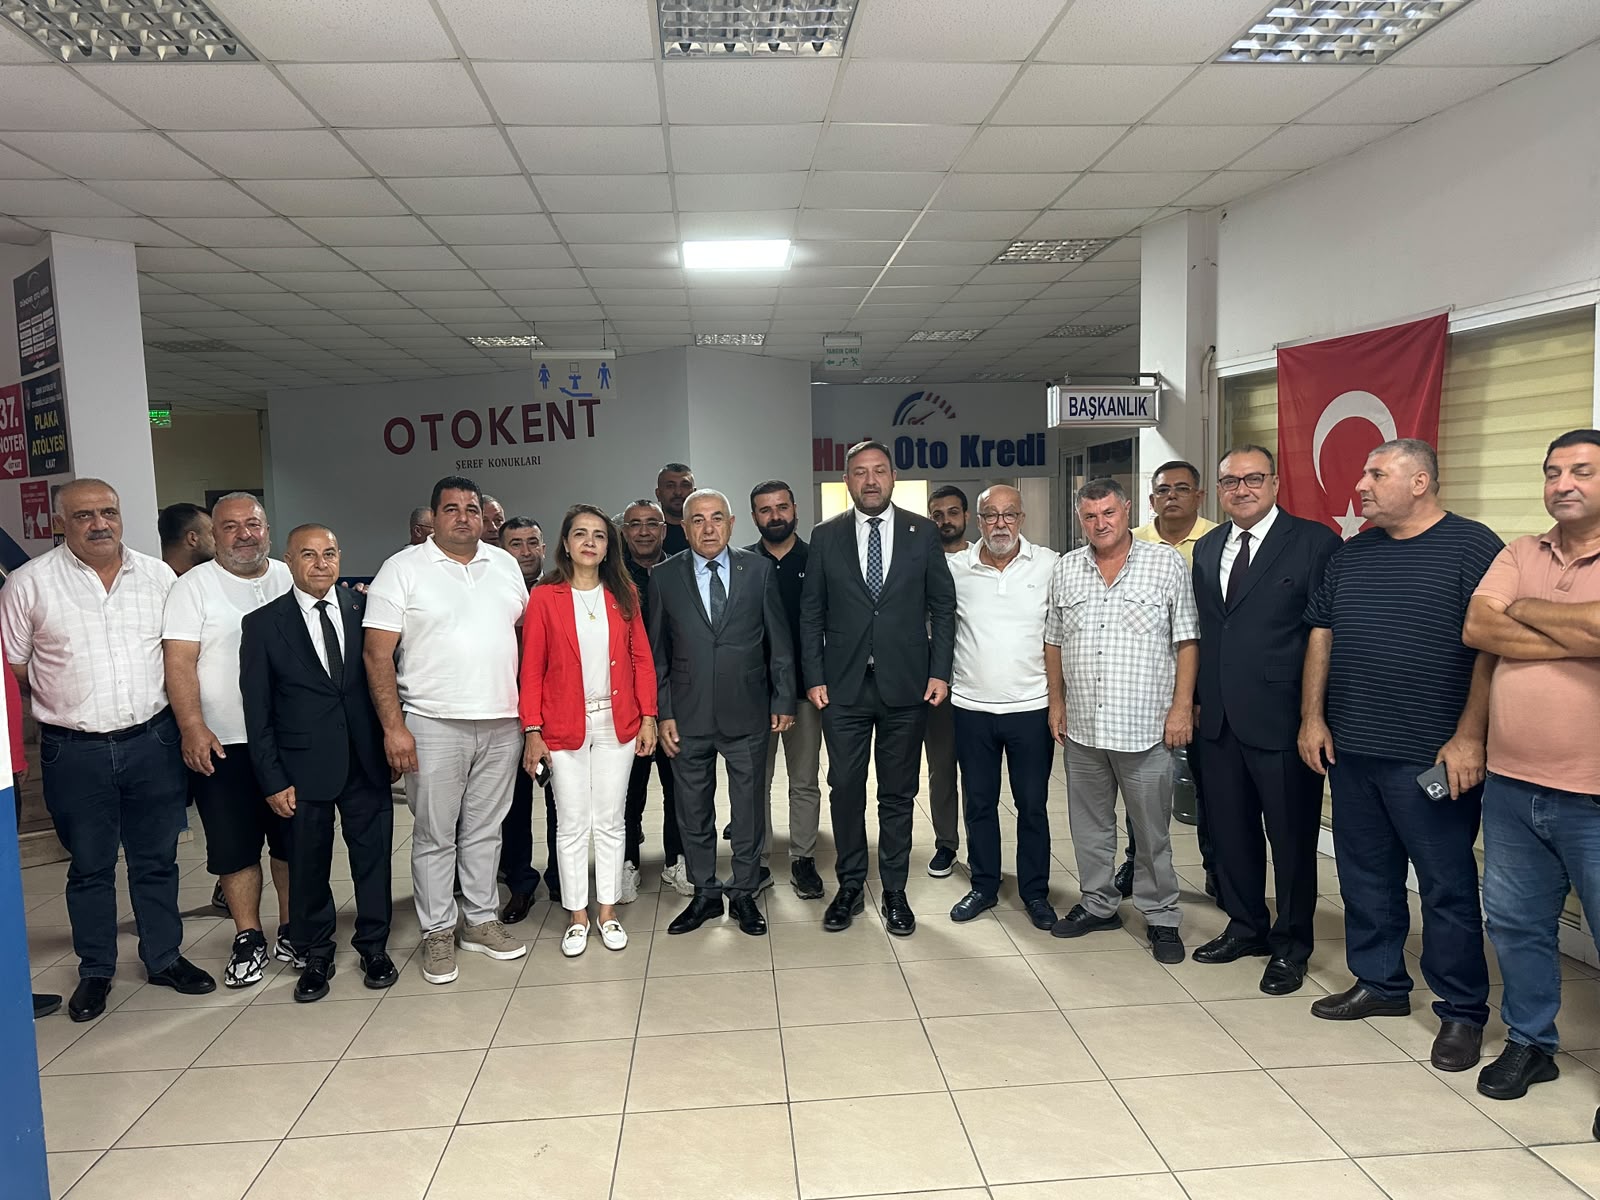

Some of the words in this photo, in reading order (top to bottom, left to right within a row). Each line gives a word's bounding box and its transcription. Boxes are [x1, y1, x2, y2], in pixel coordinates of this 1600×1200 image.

[0, 396, 19, 430] 37.
[34, 409, 59, 431] PLAKA
[1069, 396, 1148, 420] BAŞKANLIK
[383, 399, 601, 456] OTOKENT
[32, 430, 66, 457] ATÖLYESİ
[895, 436, 948, 470] Oto
[960, 432, 1046, 468] Kredi
[455, 459, 484, 471] ŞEREF
[488, 456, 541, 468] KONUKLARI
